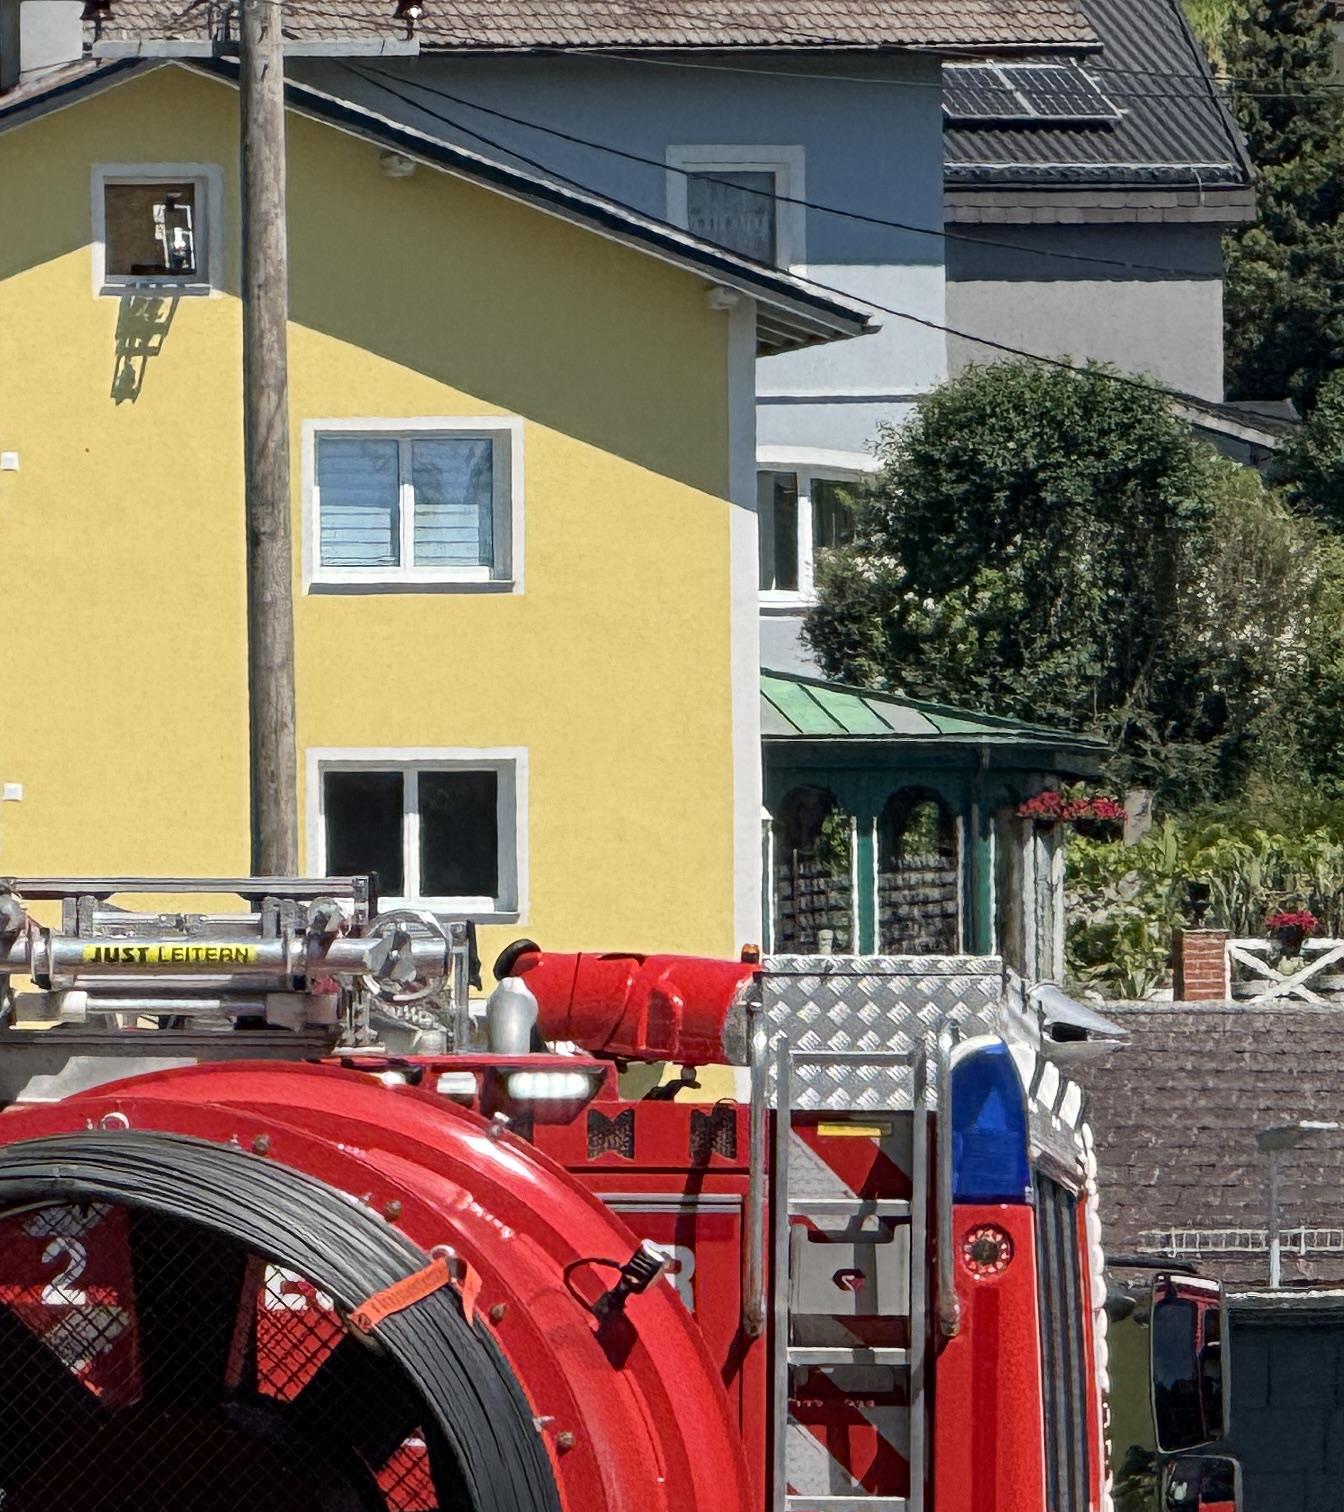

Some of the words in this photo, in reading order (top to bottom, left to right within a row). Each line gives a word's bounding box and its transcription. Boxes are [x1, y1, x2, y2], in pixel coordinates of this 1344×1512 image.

[91, 947, 149, 963] JUST
[158, 946, 249, 964] LEITERN
[41, 1235, 88, 1305] 2
